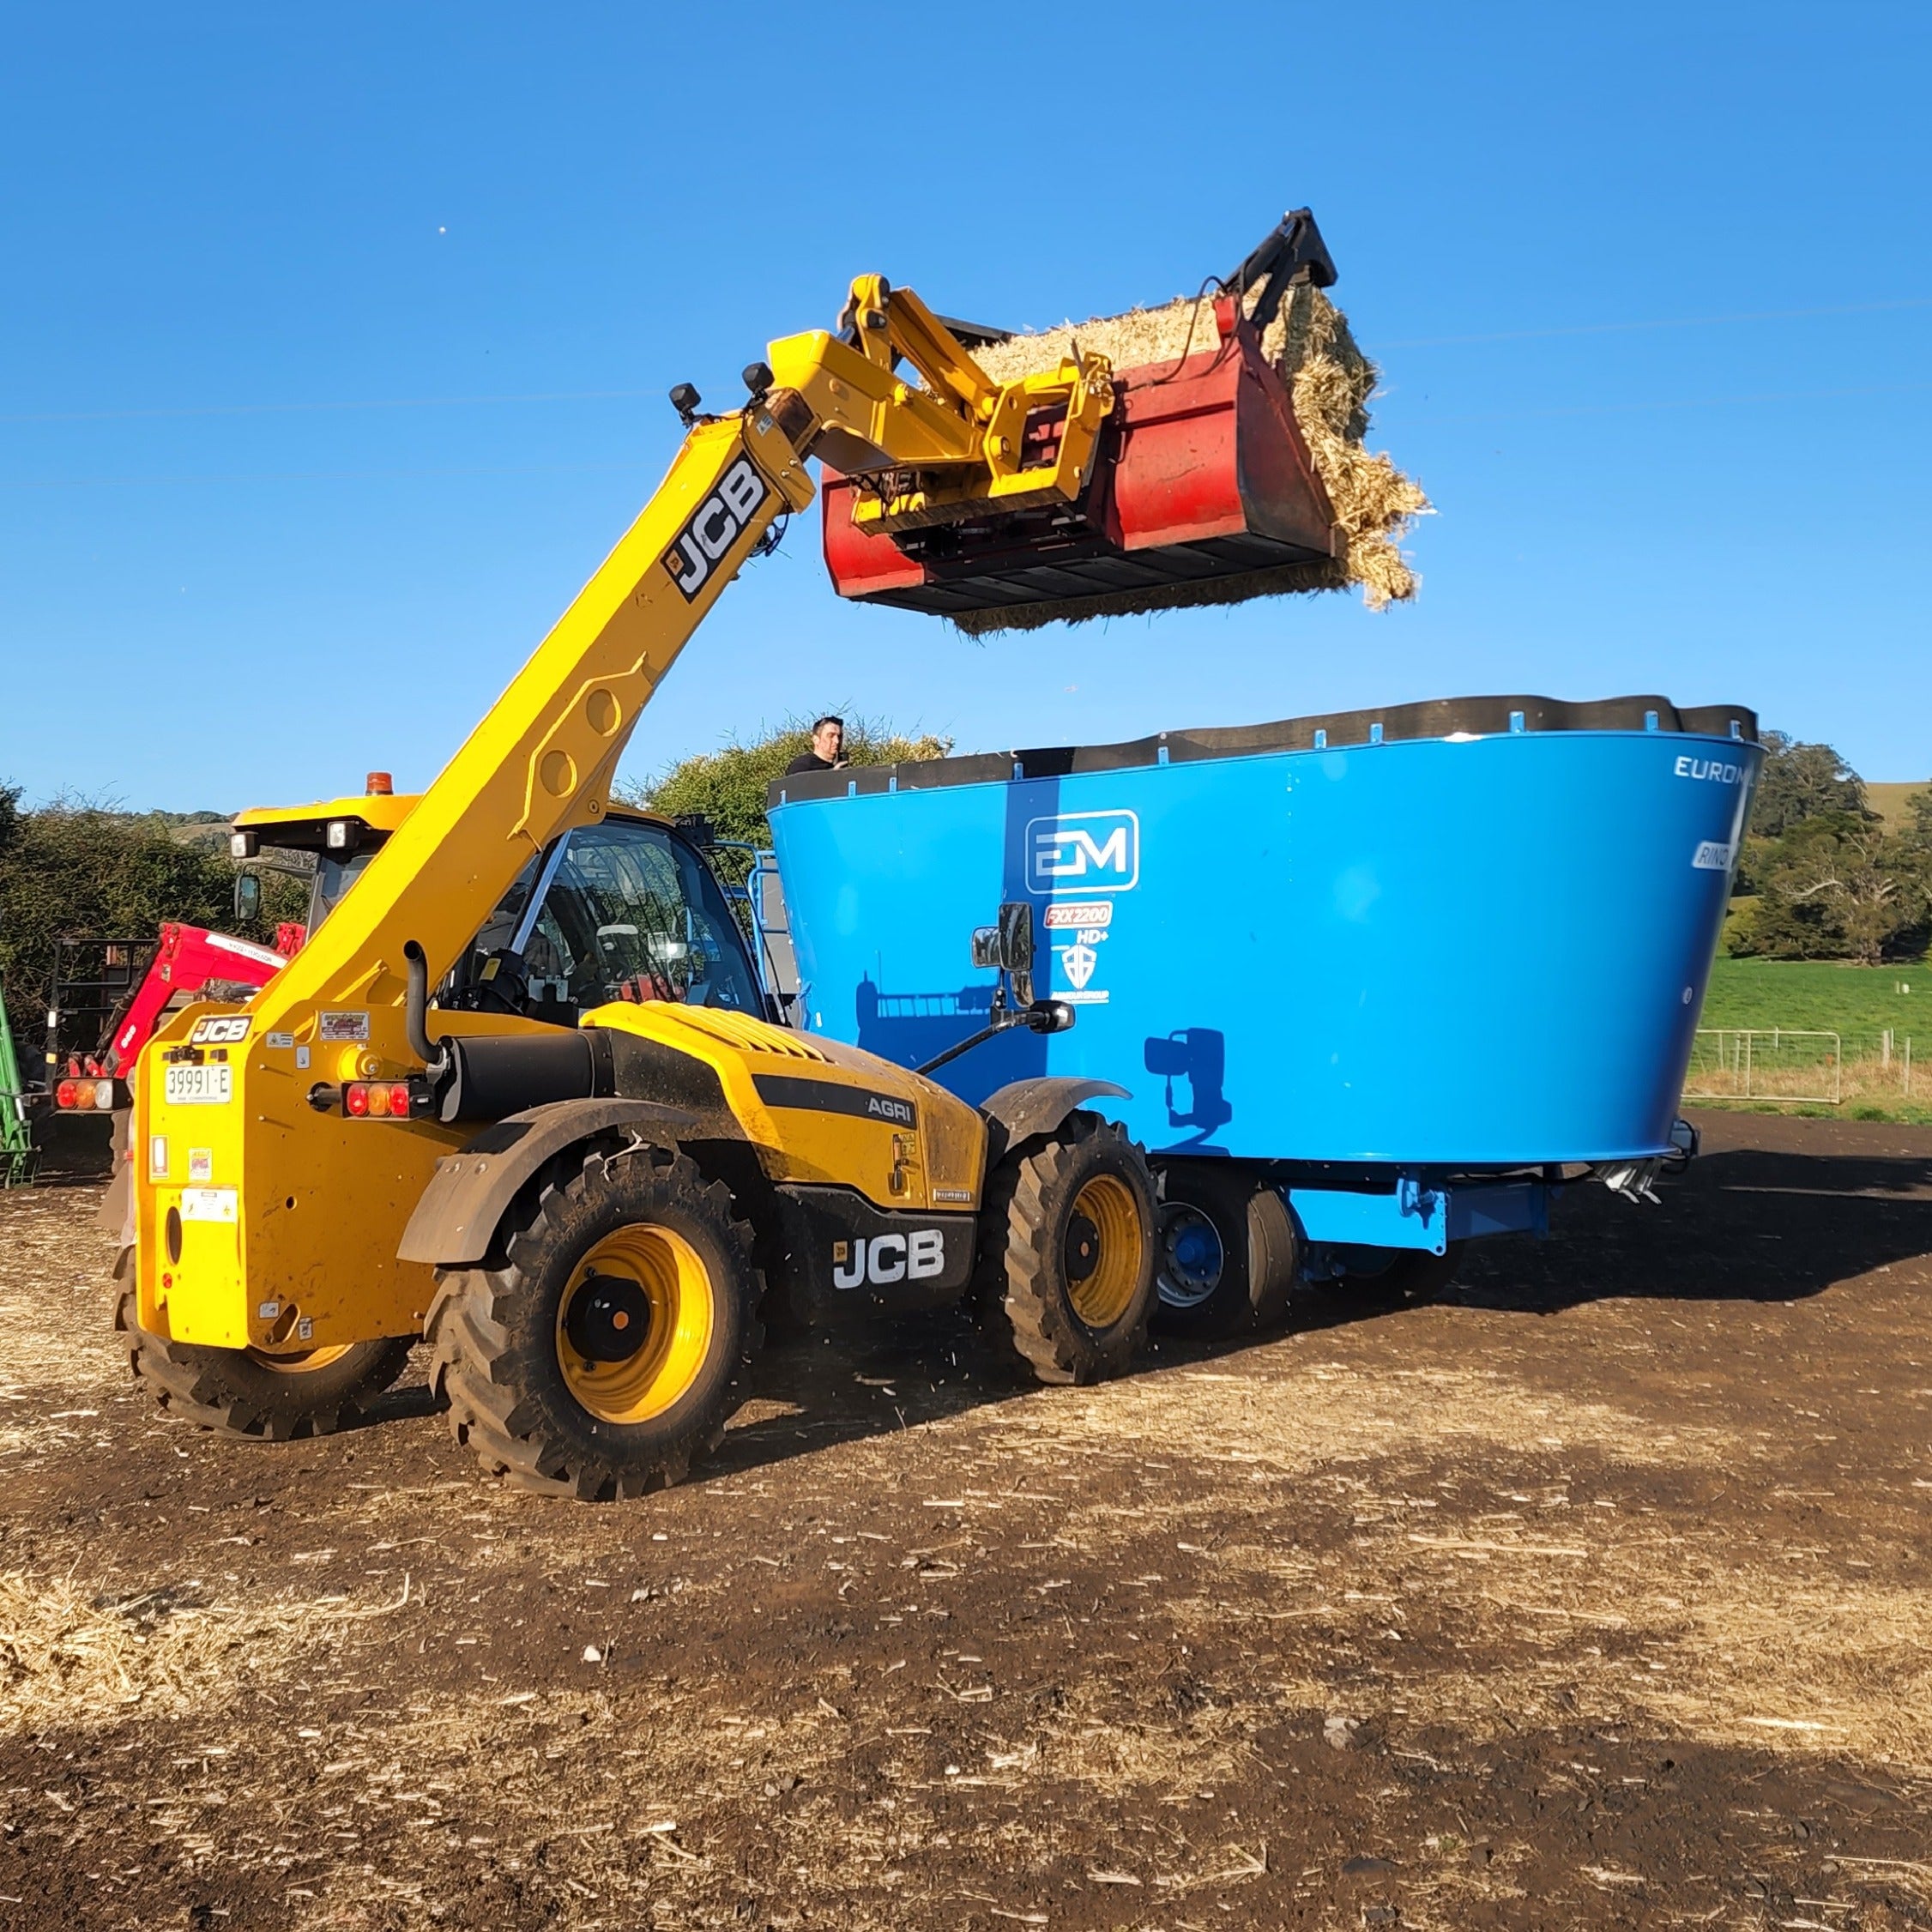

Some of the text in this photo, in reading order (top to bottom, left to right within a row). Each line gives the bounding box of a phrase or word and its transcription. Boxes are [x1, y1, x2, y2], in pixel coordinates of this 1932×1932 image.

[679, 460, 764, 593] JCB
[1035, 828, 1126, 877] EM
[193, 1018, 249, 1041] JCB
[867, 1097, 911, 1121] AGRI
[833, 1229, 945, 1289] JCB
